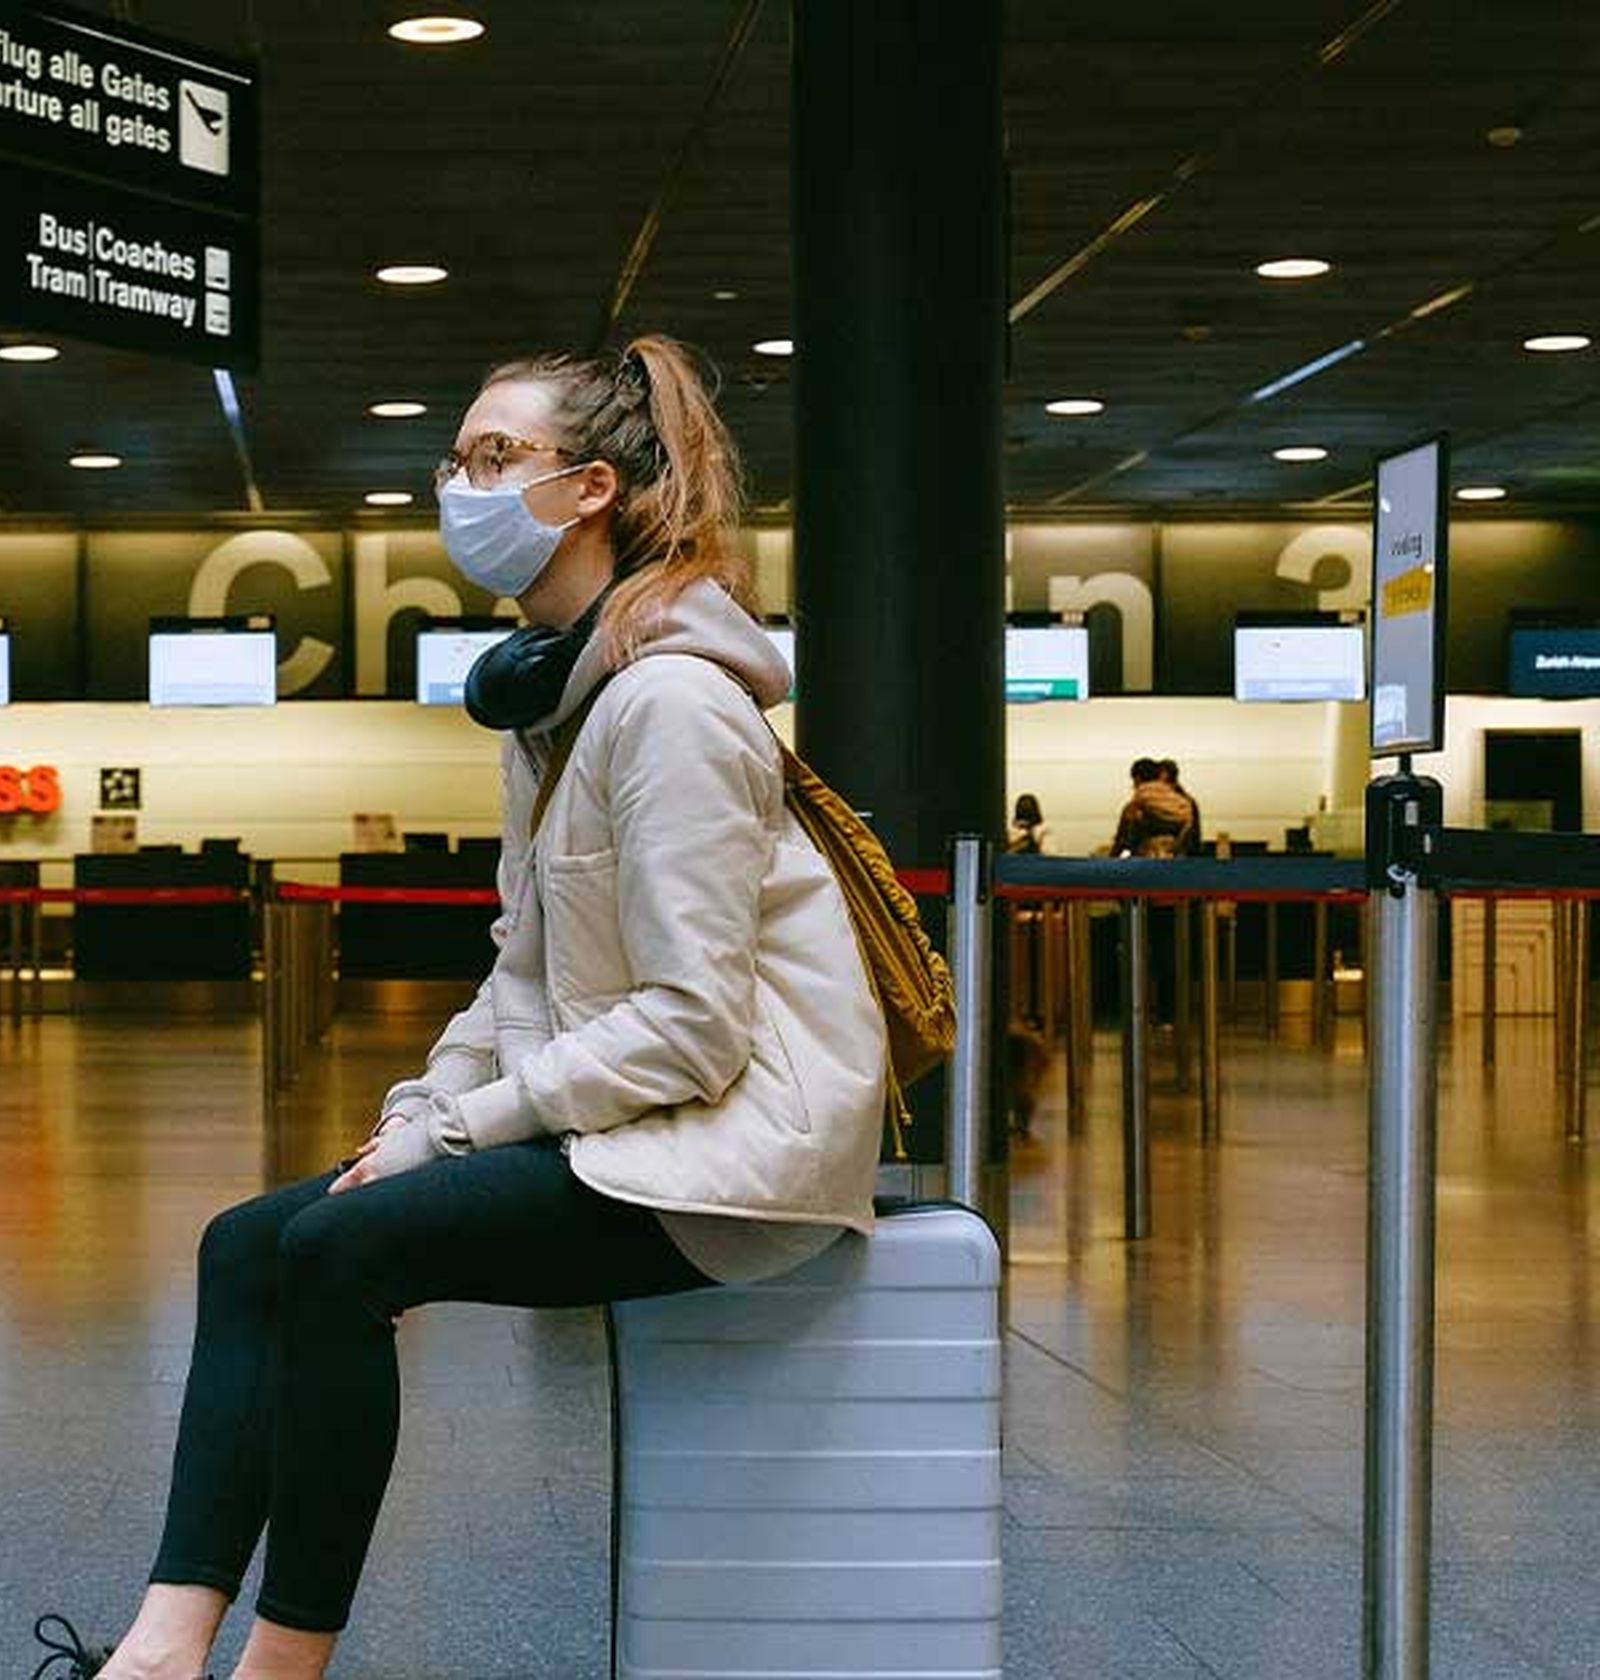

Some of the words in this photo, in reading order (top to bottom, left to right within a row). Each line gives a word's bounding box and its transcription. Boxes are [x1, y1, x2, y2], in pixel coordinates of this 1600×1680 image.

[49, 50, 94, 88] alle
[101, 63, 171, 111] Gates
[69, 97, 99, 133] all
[105, 113, 171, 153] gates
